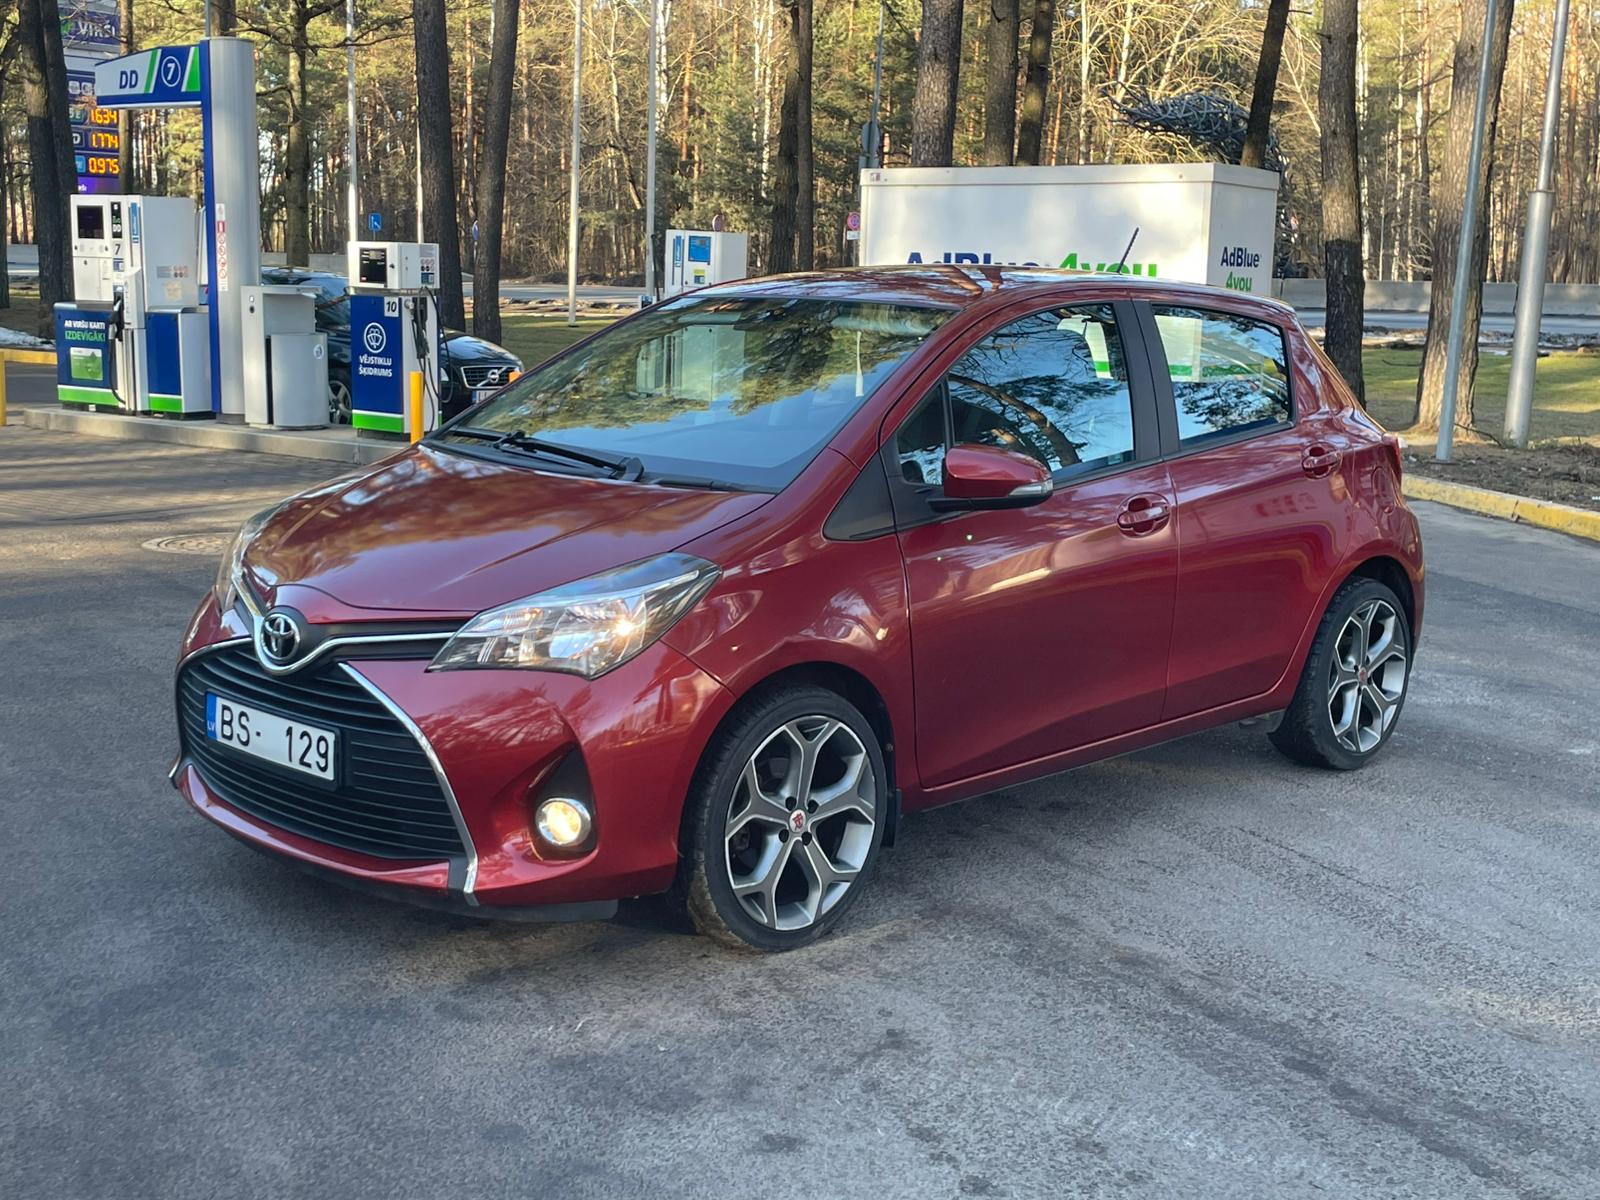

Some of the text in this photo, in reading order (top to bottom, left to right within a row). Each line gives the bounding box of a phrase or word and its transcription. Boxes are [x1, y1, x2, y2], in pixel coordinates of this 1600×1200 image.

[119, 69, 139, 89] DD
[167, 63, 176, 81] 7
[115, 243, 121, 256] 7
[1220, 246, 1260, 268] AdBlue
[386, 301, 397, 313] 10
[206, 720, 216, 732] LV
[286, 726, 329, 773] 129
